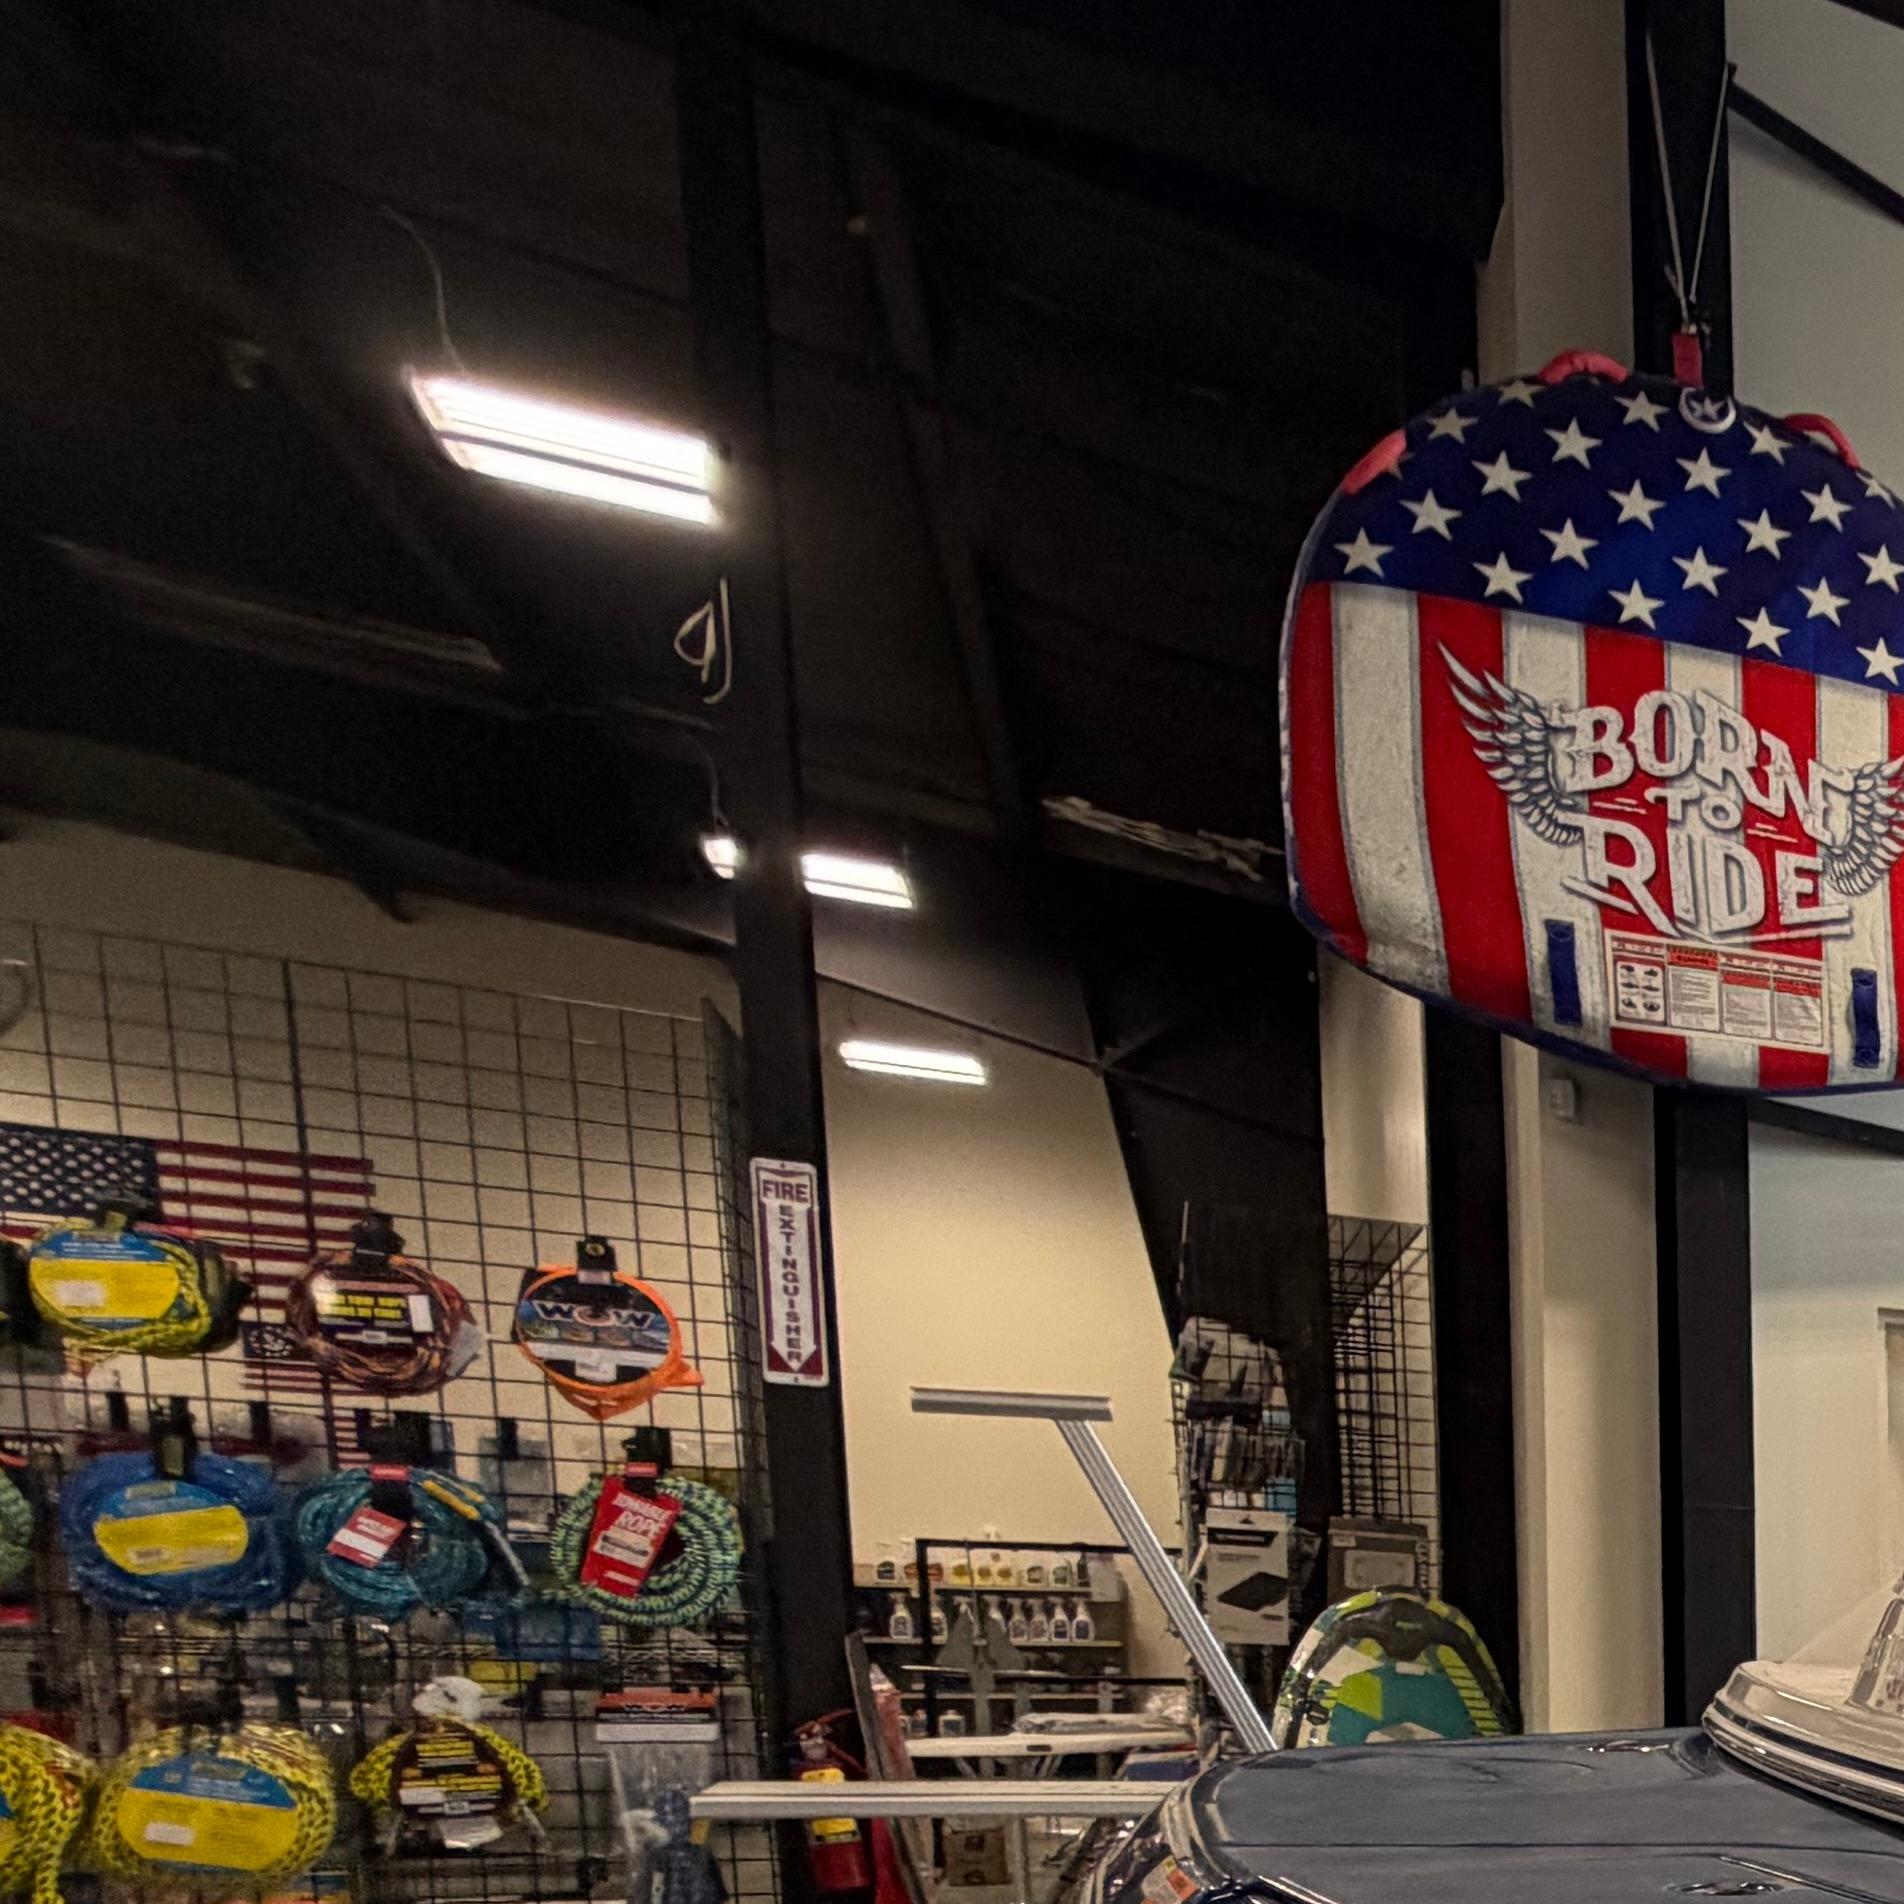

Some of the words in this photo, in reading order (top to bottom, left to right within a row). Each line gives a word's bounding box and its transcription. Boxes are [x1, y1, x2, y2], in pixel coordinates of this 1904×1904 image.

[1556, 689, 1856, 846] BORN
[1644, 782, 1743, 830] TO
[1552, 811, 1850, 938] RIDE
[762, 1179, 808, 1204] FIRE
[532, 1299, 656, 1330] WOW
[779, 1205, 802, 1362] EXTINGUISHER
